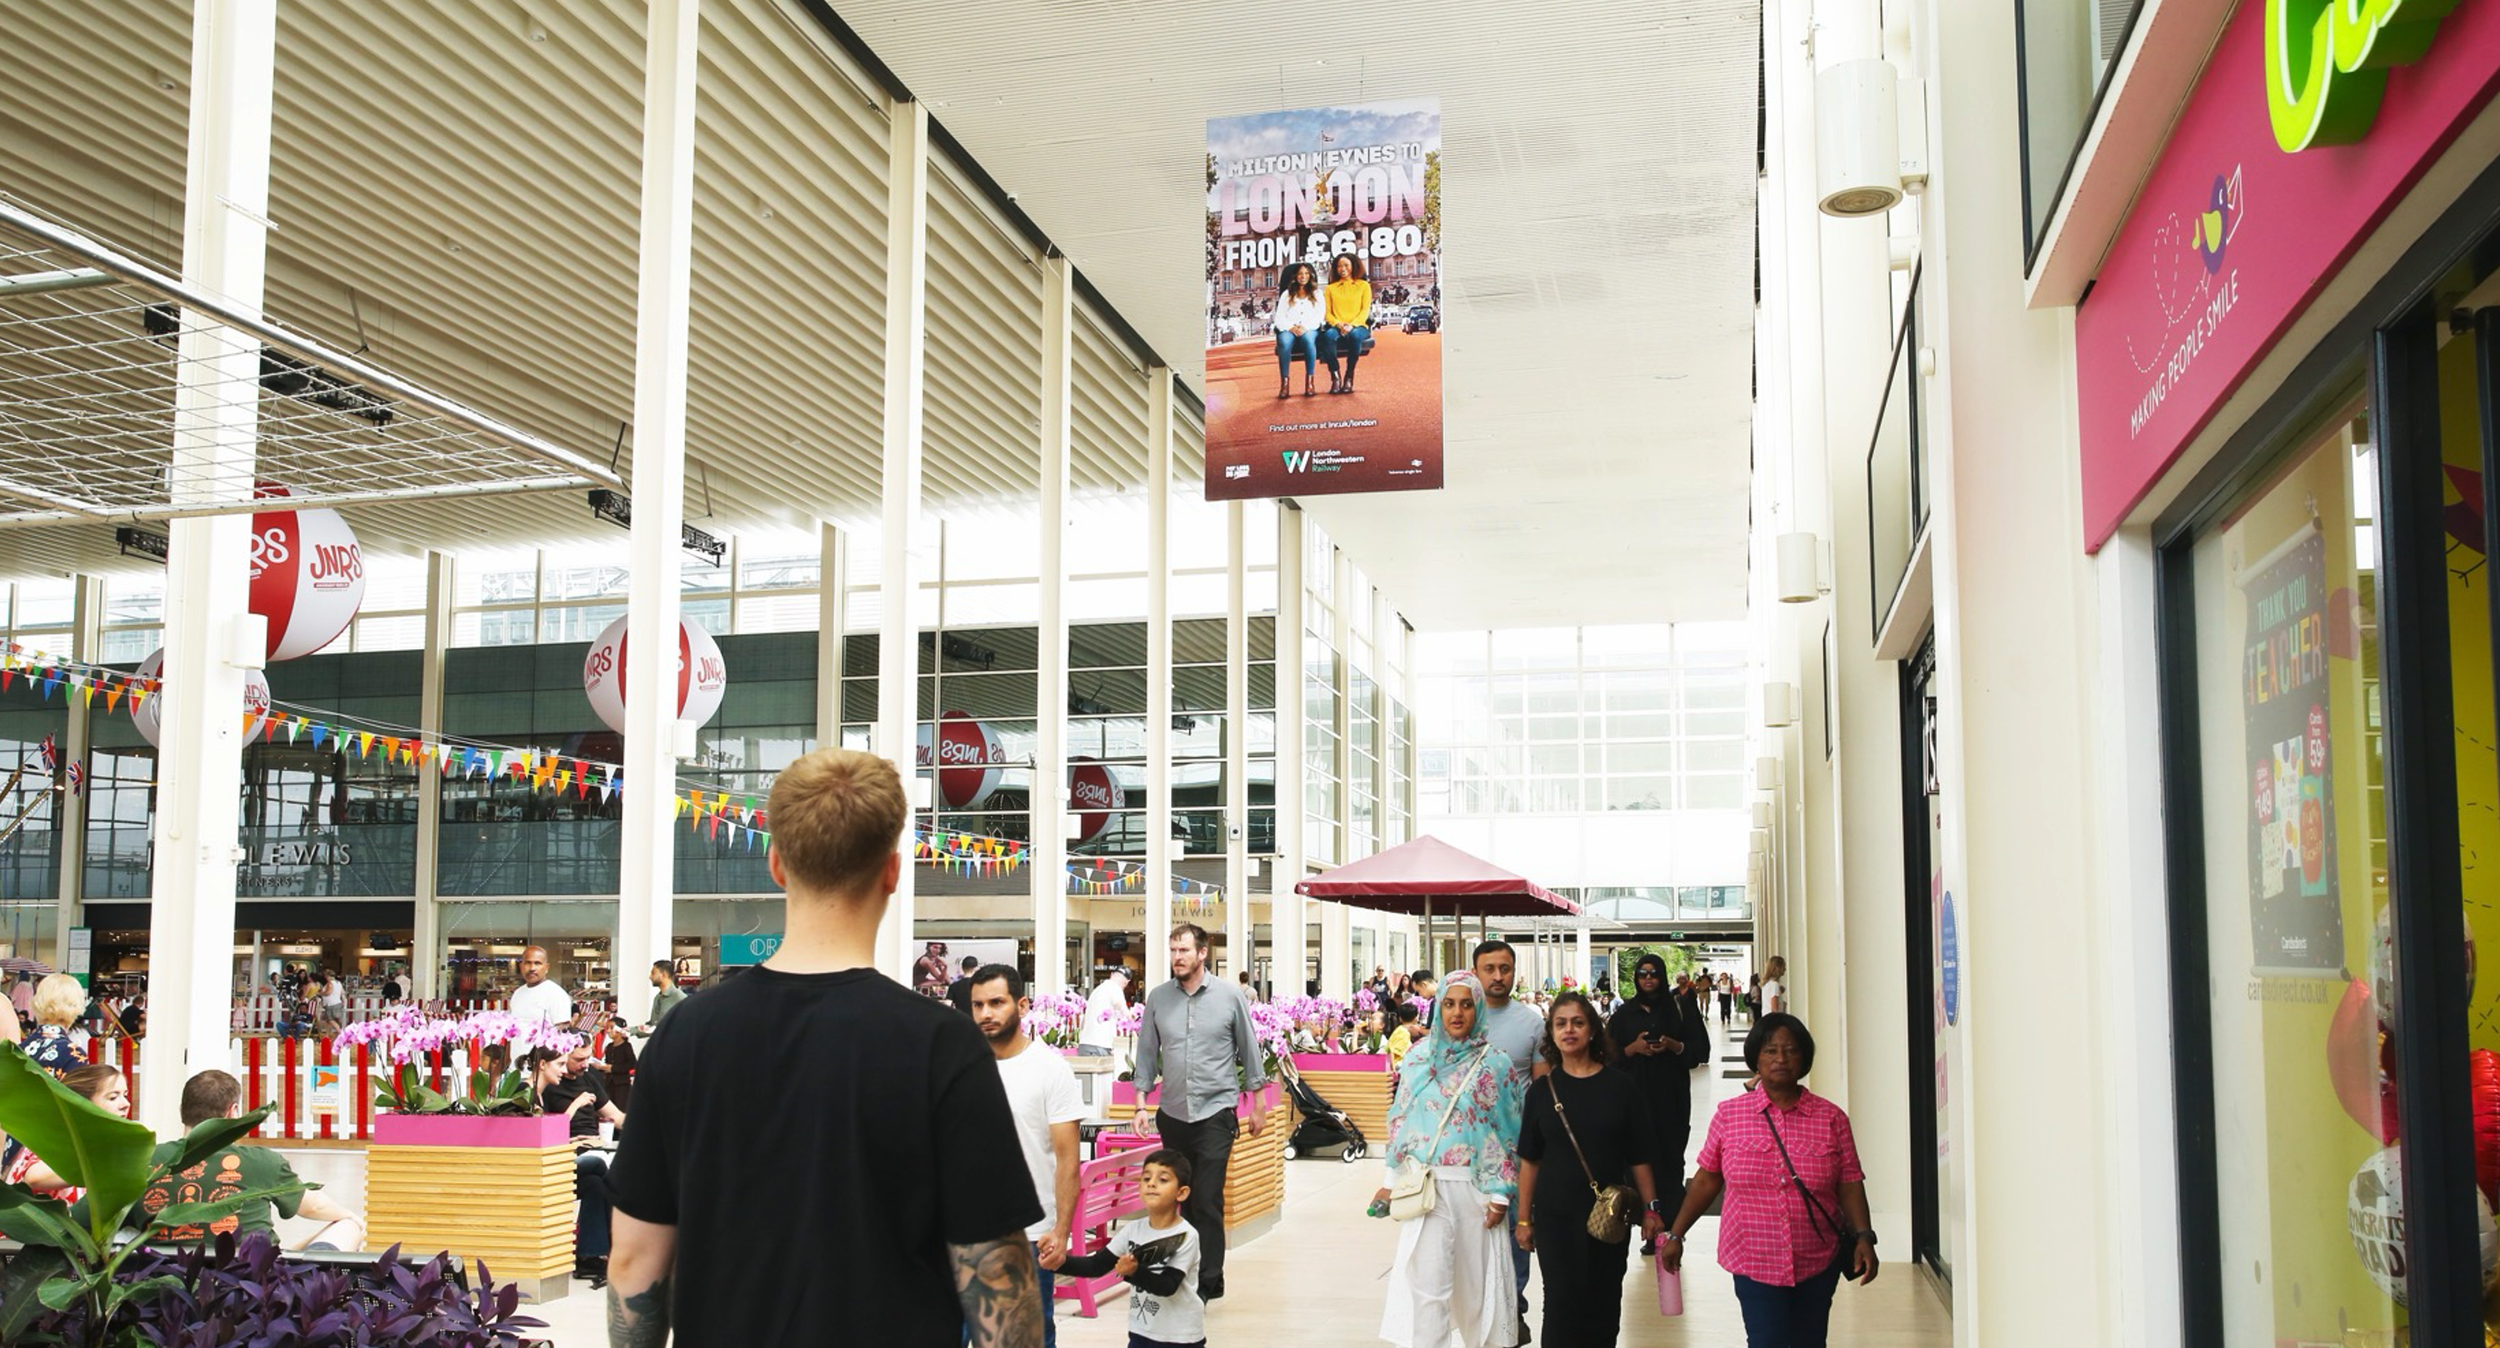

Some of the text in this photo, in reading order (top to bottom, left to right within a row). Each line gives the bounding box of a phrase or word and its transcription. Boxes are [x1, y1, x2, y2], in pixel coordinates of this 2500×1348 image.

[1228, 142, 1421, 178] MILTON KEYNES TO
[1220, 163, 1426, 237] LONDON
[1223, 224, 1422, 271] FROM £6.80
[2130, 268, 2239, 440] MAKING PEOPLE SMILE
[1269, 424, 1285, 433] Find
[1286, 423, 1299, 431] out
[1319, 421, 1328, 429] at
[1312, 449, 1341, 457] London
[1312, 455, 1365, 465] Northwestern
[1312, 464, 1341, 473] Railway
[310, 543, 363, 582] JNRS
[2257, 574, 2308, 633] THANK YOU
[697, 656, 725, 684] JNR
[2247, 610, 2323, 706] TEACHER
[2308, 712, 2323, 727] Cards
[249, 843, 351, 867] LEWIS
[236, 875, 293, 889] RTNERS
[1173, 906, 1214, 918] LEWIS
[750, 938, 785, 957] OR
[2247, 979, 2330, 1005] cardsdirect.co.uk
[2352, 1232, 2407, 1279] RAD
